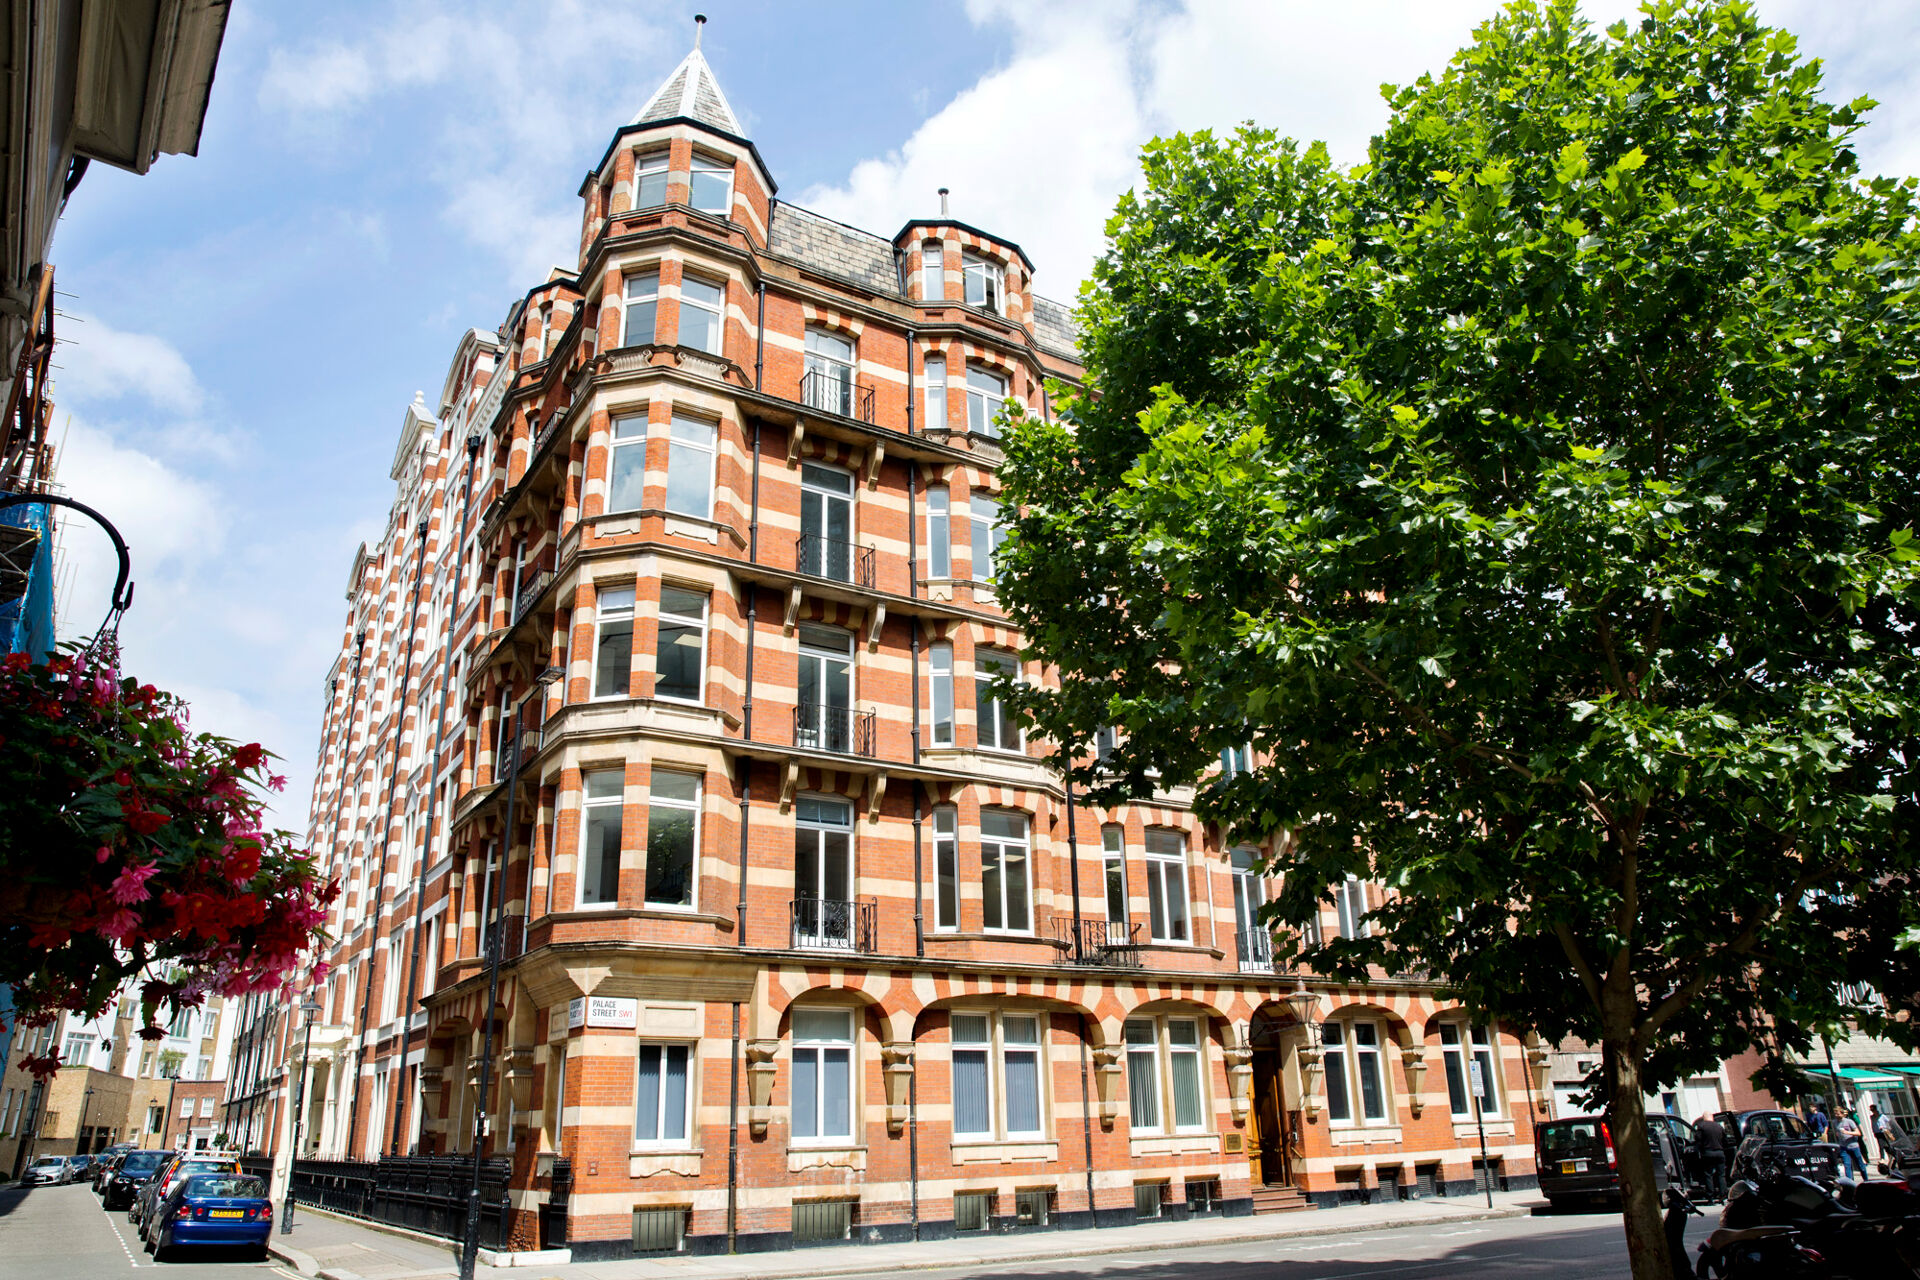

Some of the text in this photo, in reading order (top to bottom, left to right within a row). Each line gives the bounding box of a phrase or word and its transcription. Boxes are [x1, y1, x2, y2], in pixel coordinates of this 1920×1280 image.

[592, 1000, 617, 1008] PALACE
[592, 1009, 617, 1017] STREET
[618, 1010, 633, 1018] SW1
